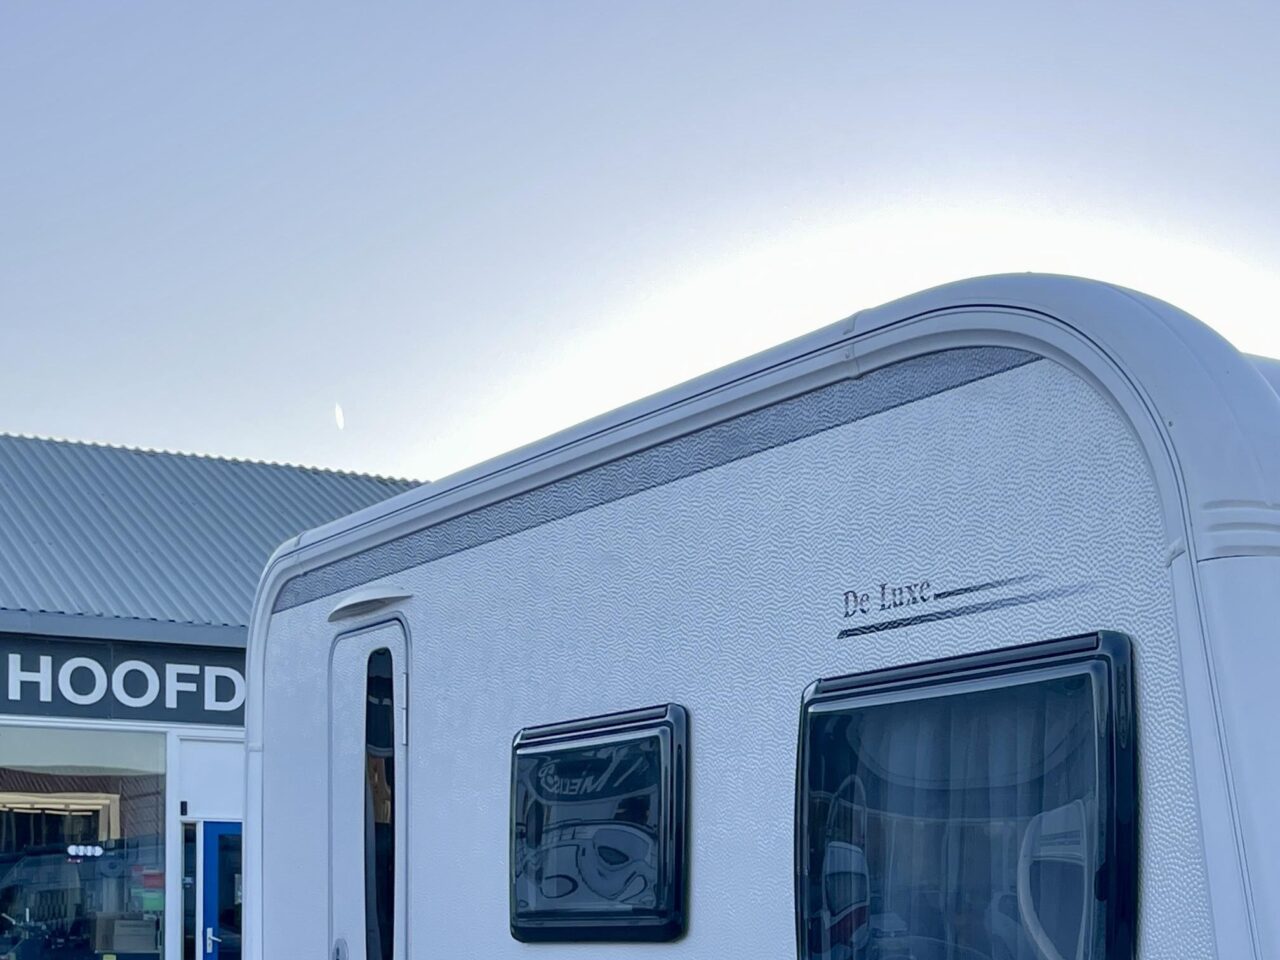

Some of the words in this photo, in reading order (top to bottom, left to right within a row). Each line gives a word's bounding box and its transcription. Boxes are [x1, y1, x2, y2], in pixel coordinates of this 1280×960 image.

[843, 590, 870, 618] De
[879, 583, 931, 612] Luxe
[7, 653, 246, 711] HOOFD
